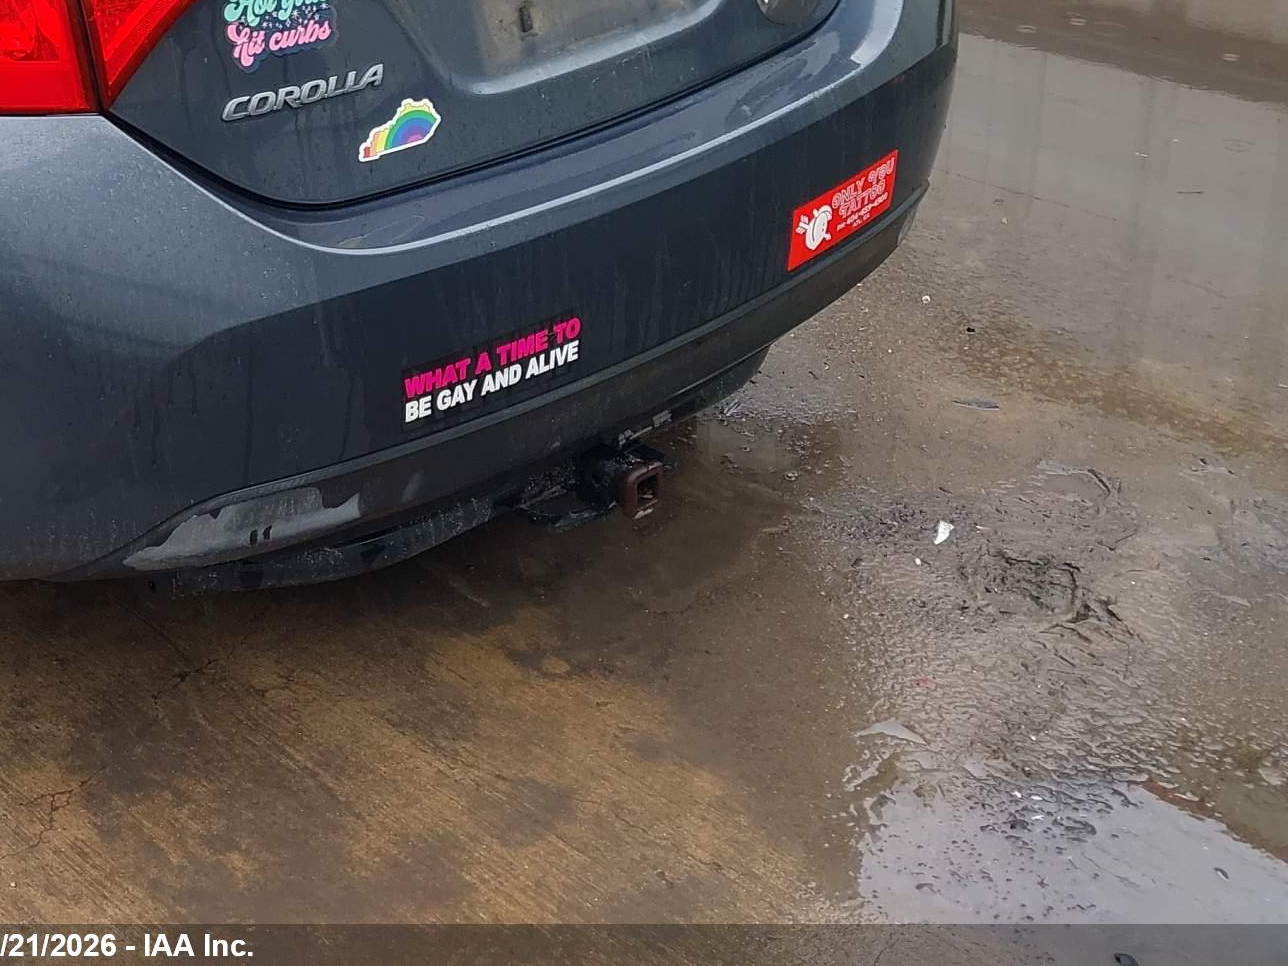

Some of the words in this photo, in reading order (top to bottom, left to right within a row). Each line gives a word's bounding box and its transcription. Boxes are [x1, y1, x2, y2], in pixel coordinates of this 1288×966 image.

[269, 19, 332, 52] curbs
[221, 63, 384, 122] COROLLA
[832, 176, 866, 209] ONLY
[838, 179, 886, 218] TATTOO
[404, 357, 471, 399] WHAT
[475, 352, 492, 374] A
[496, 330, 550, 367] TIME
[553, 317, 582, 343] TO
[405, 395, 432, 423] BE
[436, 379, 477, 411] GAY
[481, 362, 522, 395] AND
[525, 339, 580, 379] ALIVE
